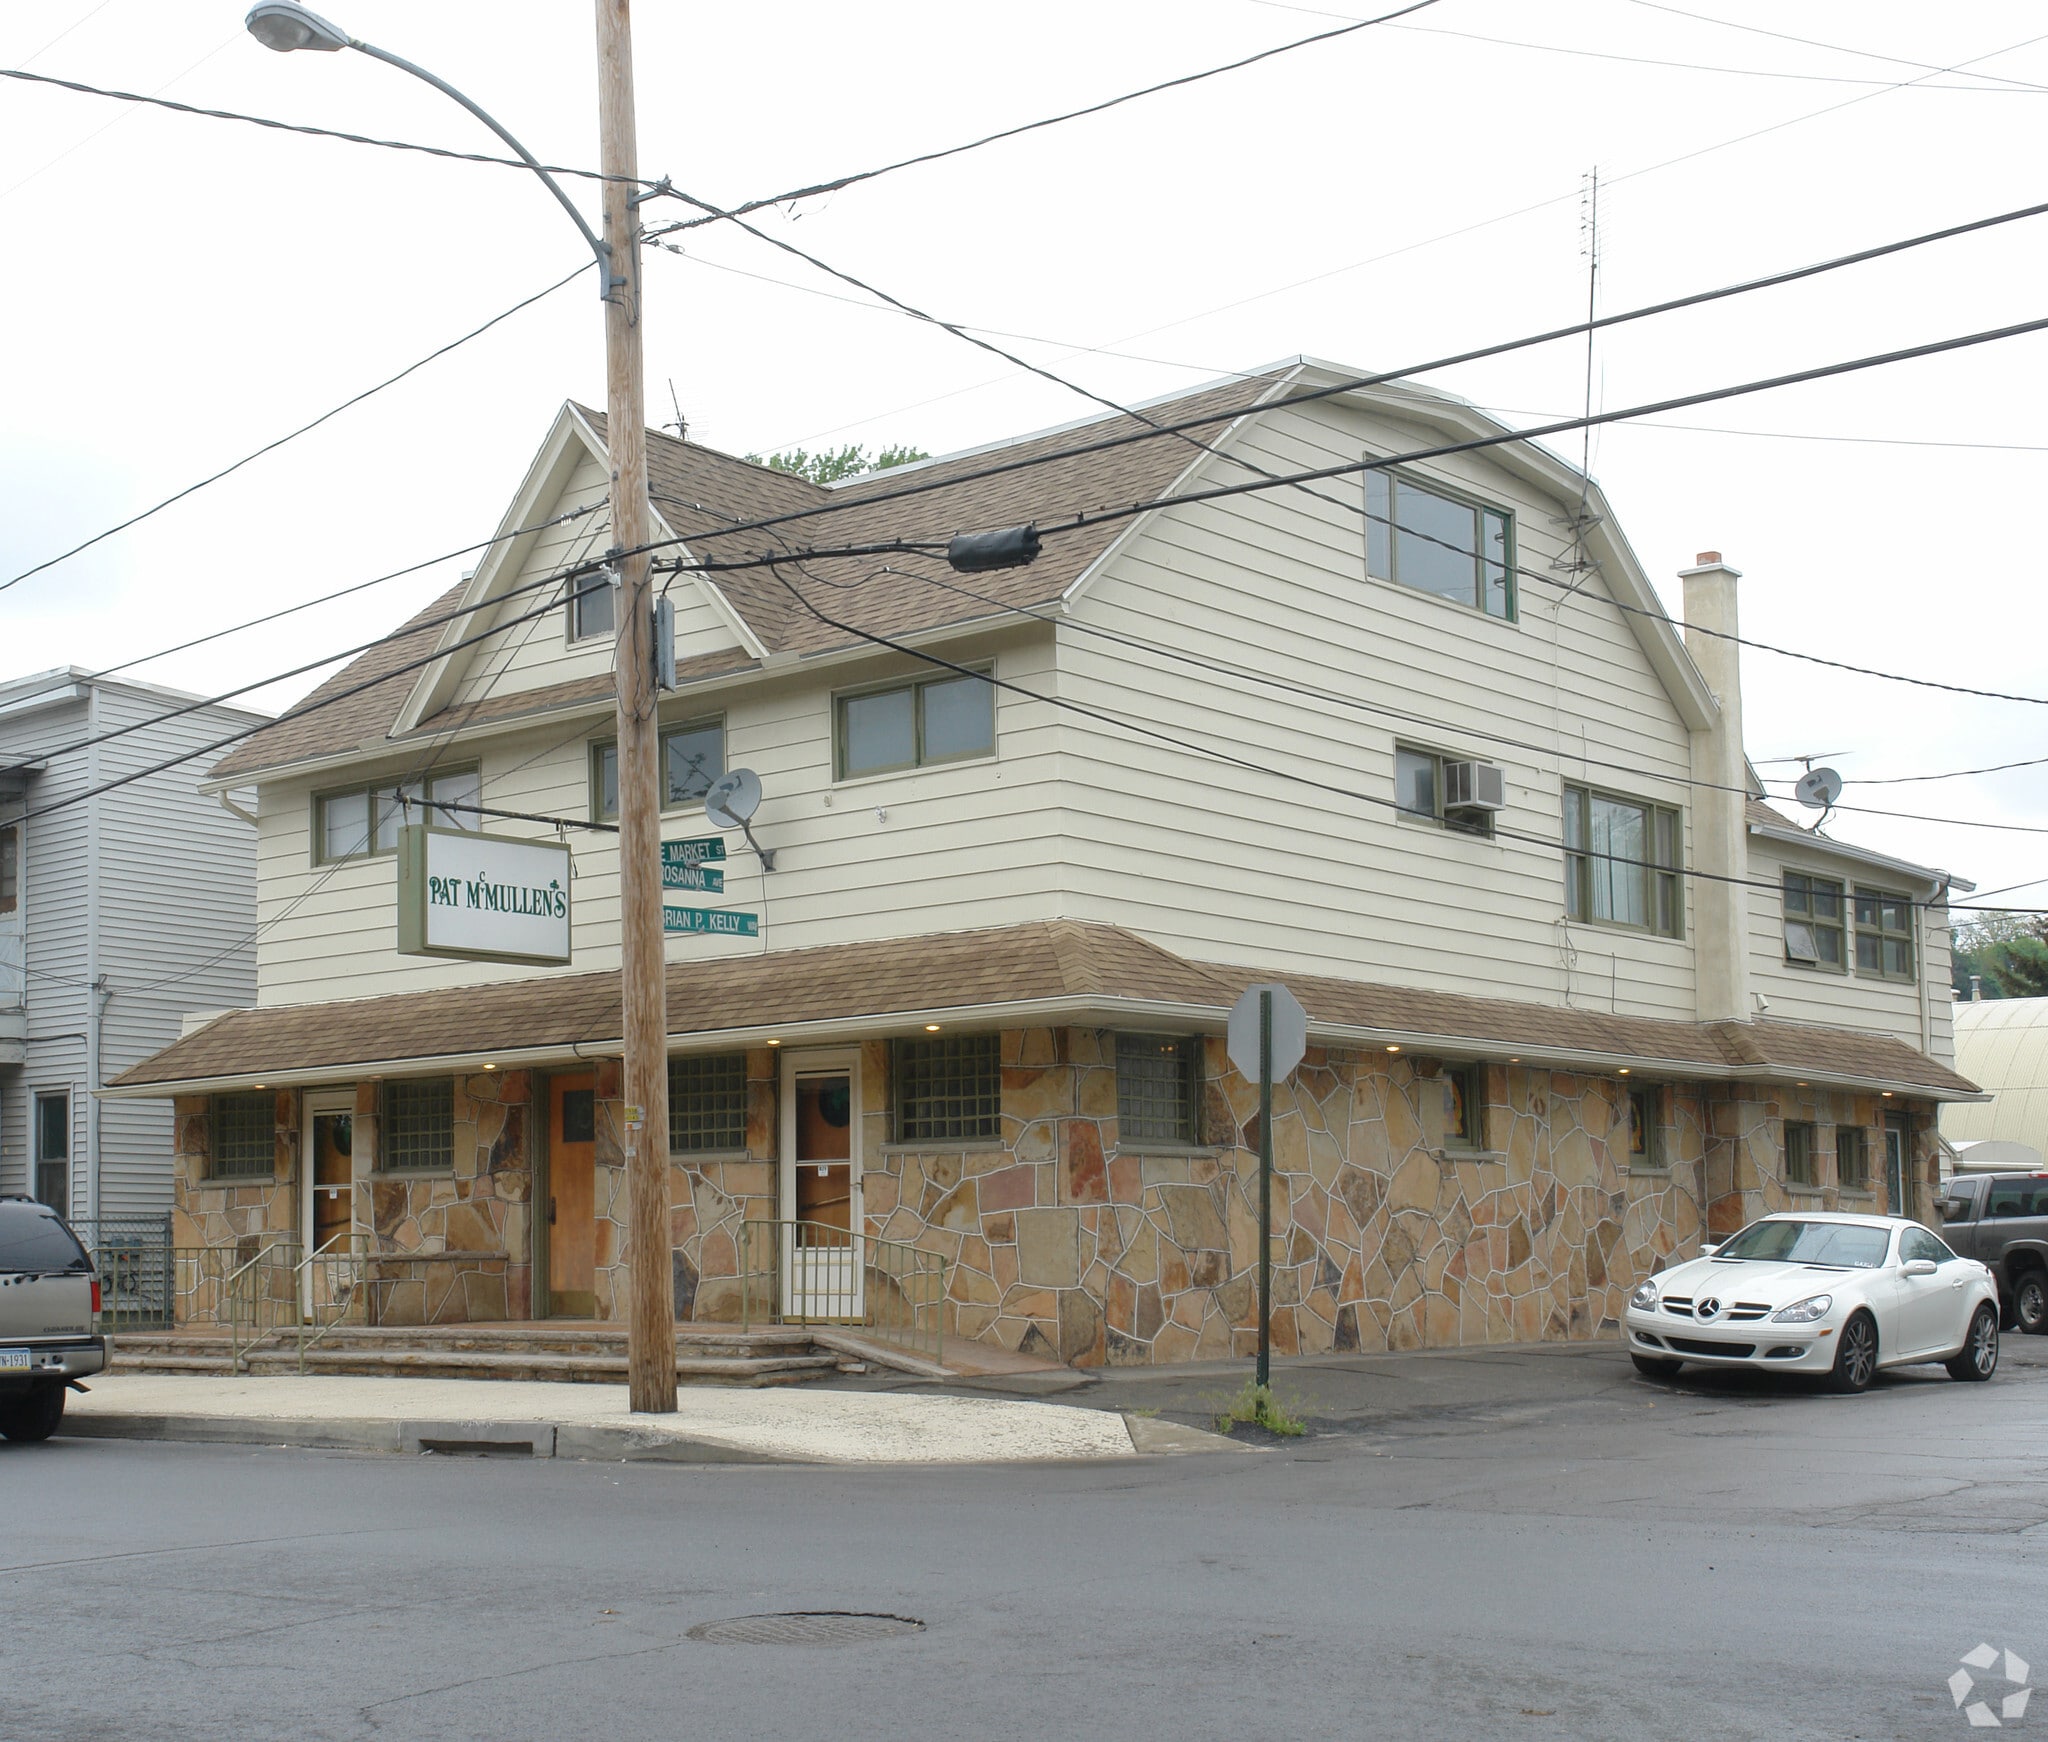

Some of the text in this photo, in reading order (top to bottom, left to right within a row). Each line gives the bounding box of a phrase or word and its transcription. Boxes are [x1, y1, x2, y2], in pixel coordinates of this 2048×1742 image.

[669, 842, 710, 861] MARKET
[716, 845, 725, 855] ST
[429, 876, 462, 907] PAT
[709, 913, 740, 932] KELLY
[0, 1354, 28, 1367] N-1931
